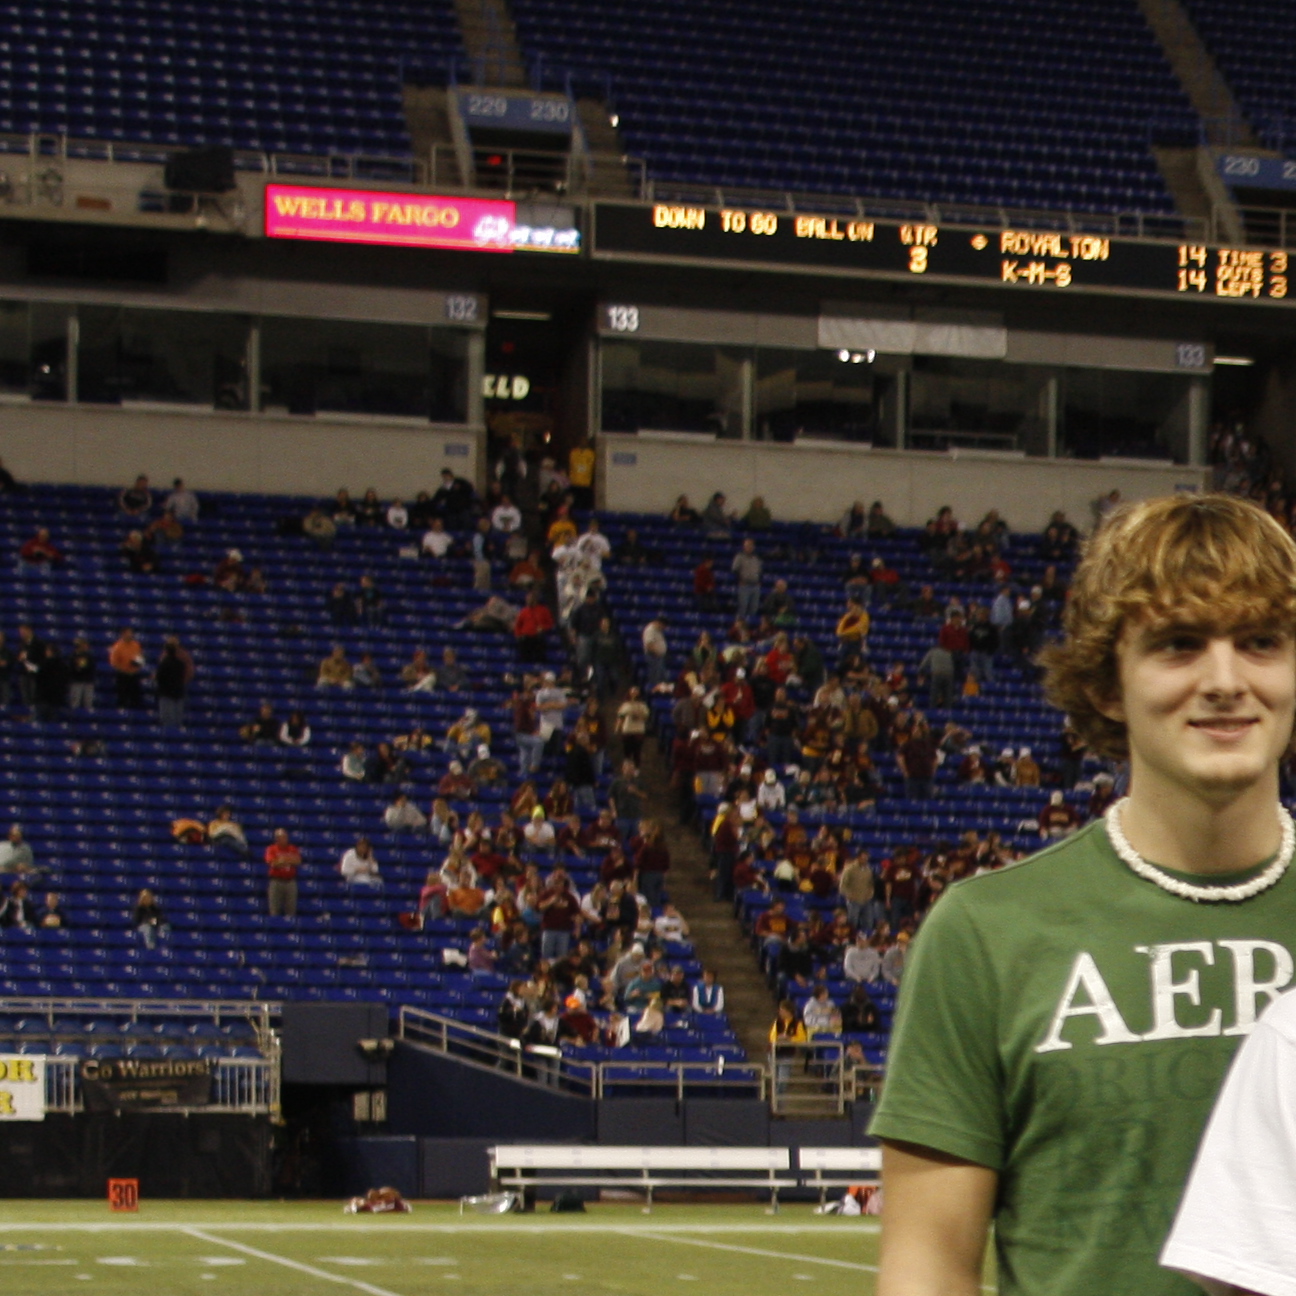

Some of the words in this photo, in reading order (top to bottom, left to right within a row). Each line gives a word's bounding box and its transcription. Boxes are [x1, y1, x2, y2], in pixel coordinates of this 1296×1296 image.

[1223, 156, 1260, 176] 230
[274, 195, 366, 223] WELLS
[371, 201, 460, 228] FARGO
[654, 204, 705, 230] DOWN
[720, 209, 746, 233] TO
[751, 212, 777, 236] GO
[795, 216, 845, 241] BALL
[1000, 230, 1110, 261] ROYALTON
[1177, 245, 1207, 268] 14
[1217, 249, 1264, 268] TIME
[1177, 268, 1207, 293] 14
[1216, 279, 1264, 299] LEFT
[448, 296, 478, 320] 132
[608, 305, 640, 332] 133
[82, 1060, 113, 1081] Go
[112, 1184, 137, 1208] 30
